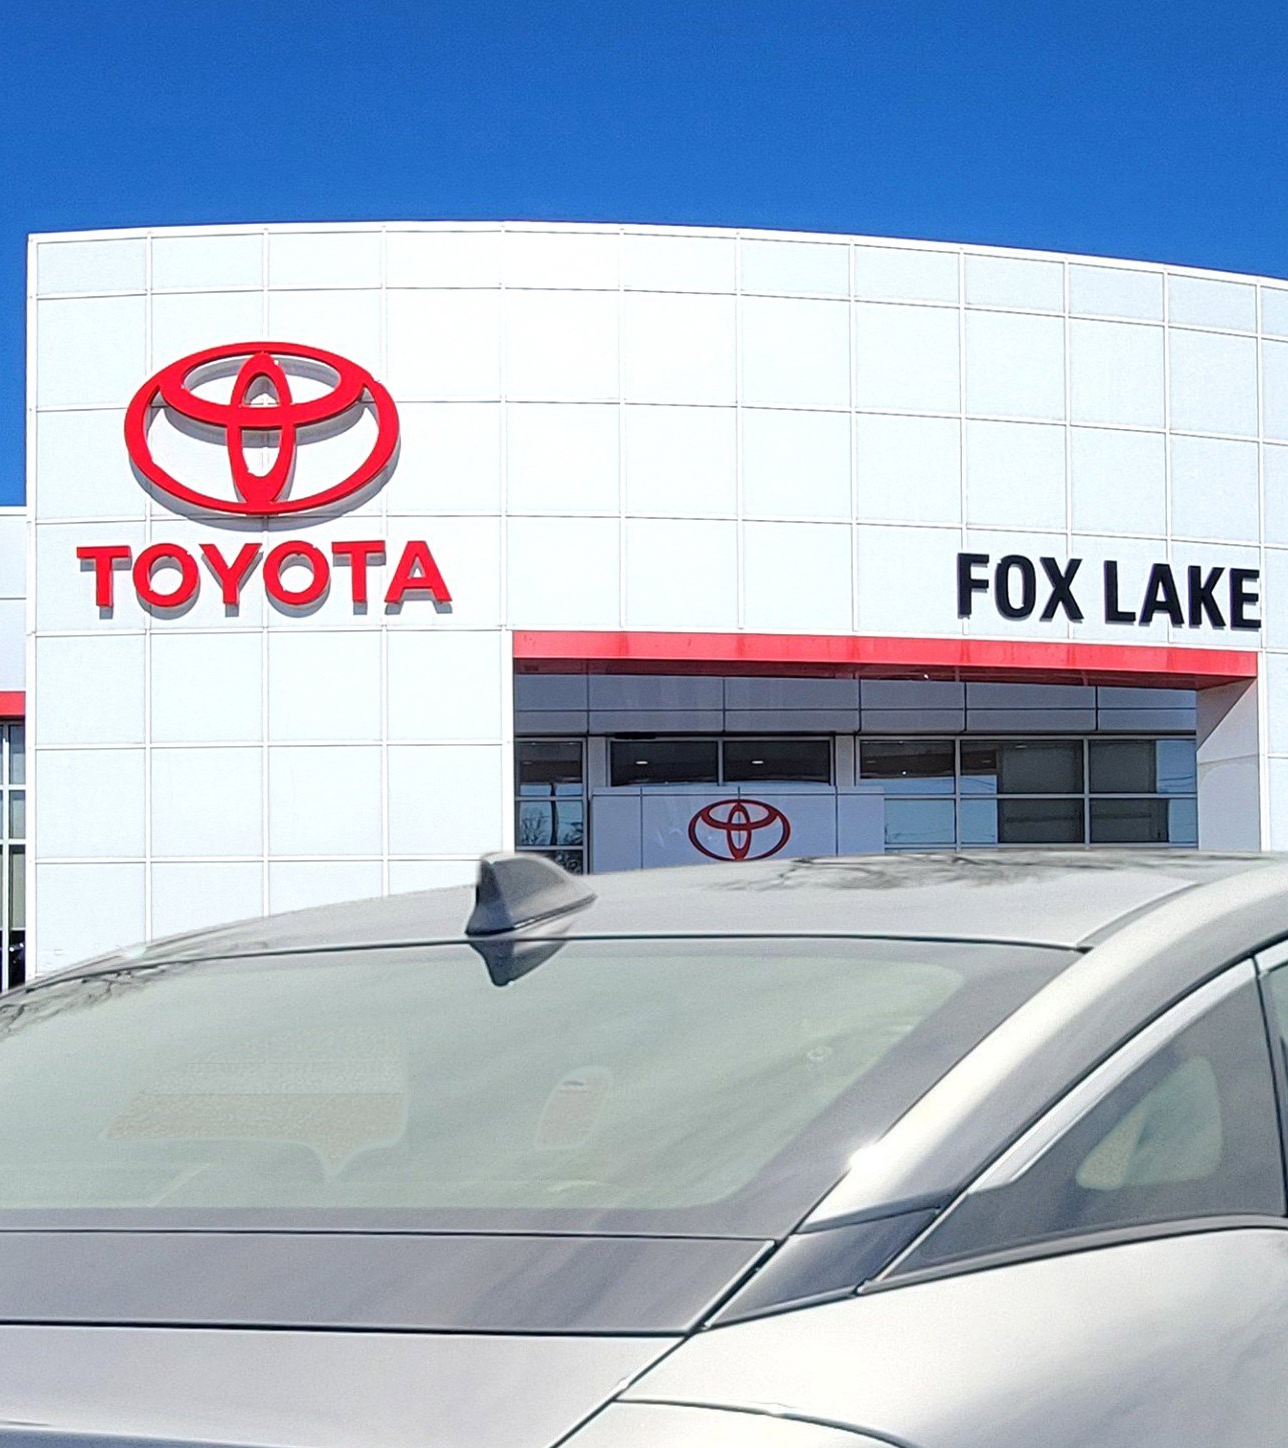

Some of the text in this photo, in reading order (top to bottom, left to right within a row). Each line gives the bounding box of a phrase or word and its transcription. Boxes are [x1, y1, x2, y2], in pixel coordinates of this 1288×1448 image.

[76, 540, 453, 612] TOYOTA
[957, 552, 1262, 630] FOX LAKE
